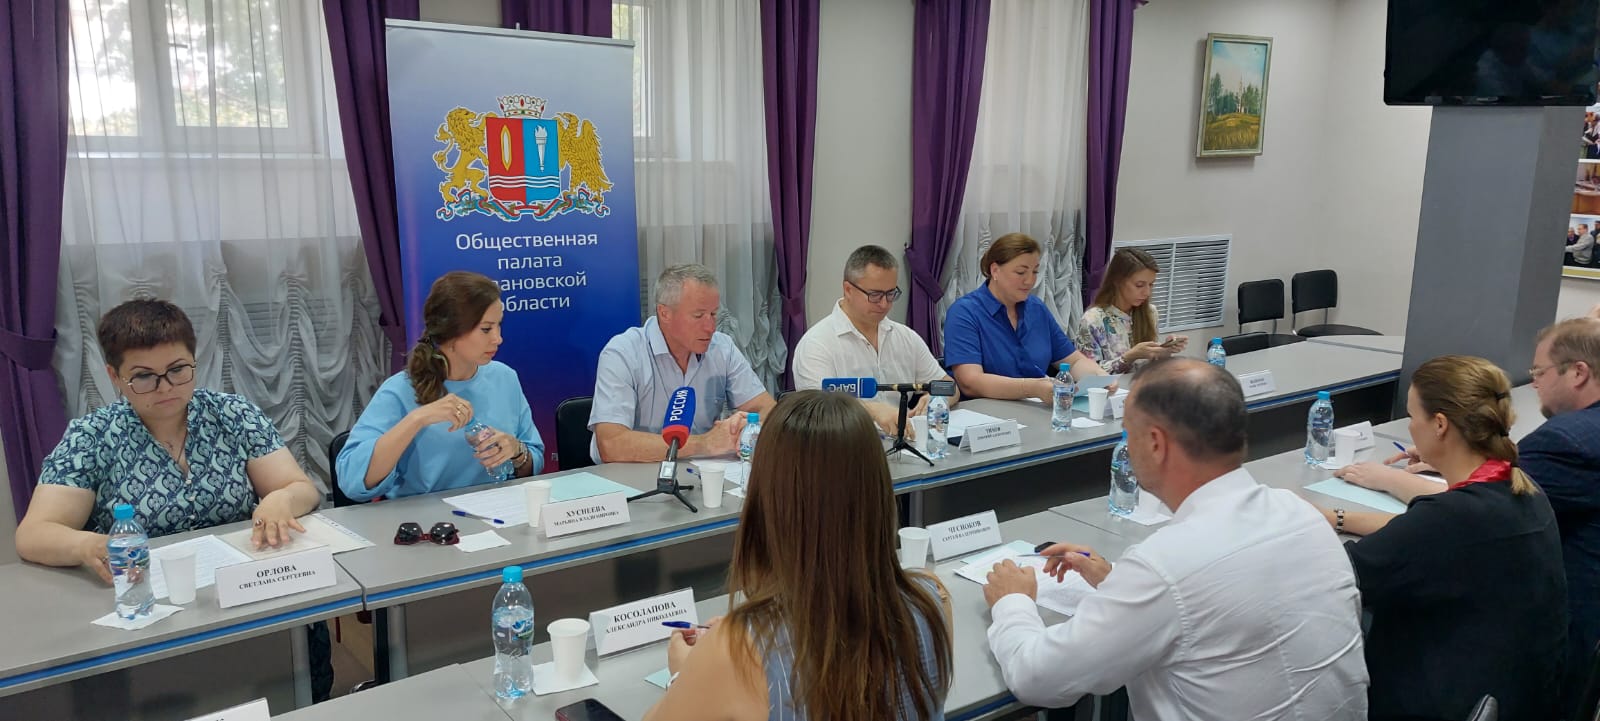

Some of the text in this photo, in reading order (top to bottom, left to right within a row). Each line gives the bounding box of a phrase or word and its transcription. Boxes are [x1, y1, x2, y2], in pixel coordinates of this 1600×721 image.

[455, 232, 598, 251] Общественная
[498, 255, 562, 270] палата
[492, 271, 587, 291] ановской
[827, 383, 856, 393] БАРС
[669, 389, 689, 422] РОССИЯ
[239, 570, 316, 590] СВЕТЛАНА СЕРГЕЕВНА
[256, 564, 297, 578] ОРЛОВА
[613, 601, 677, 623] КОСОЛАПОВА
